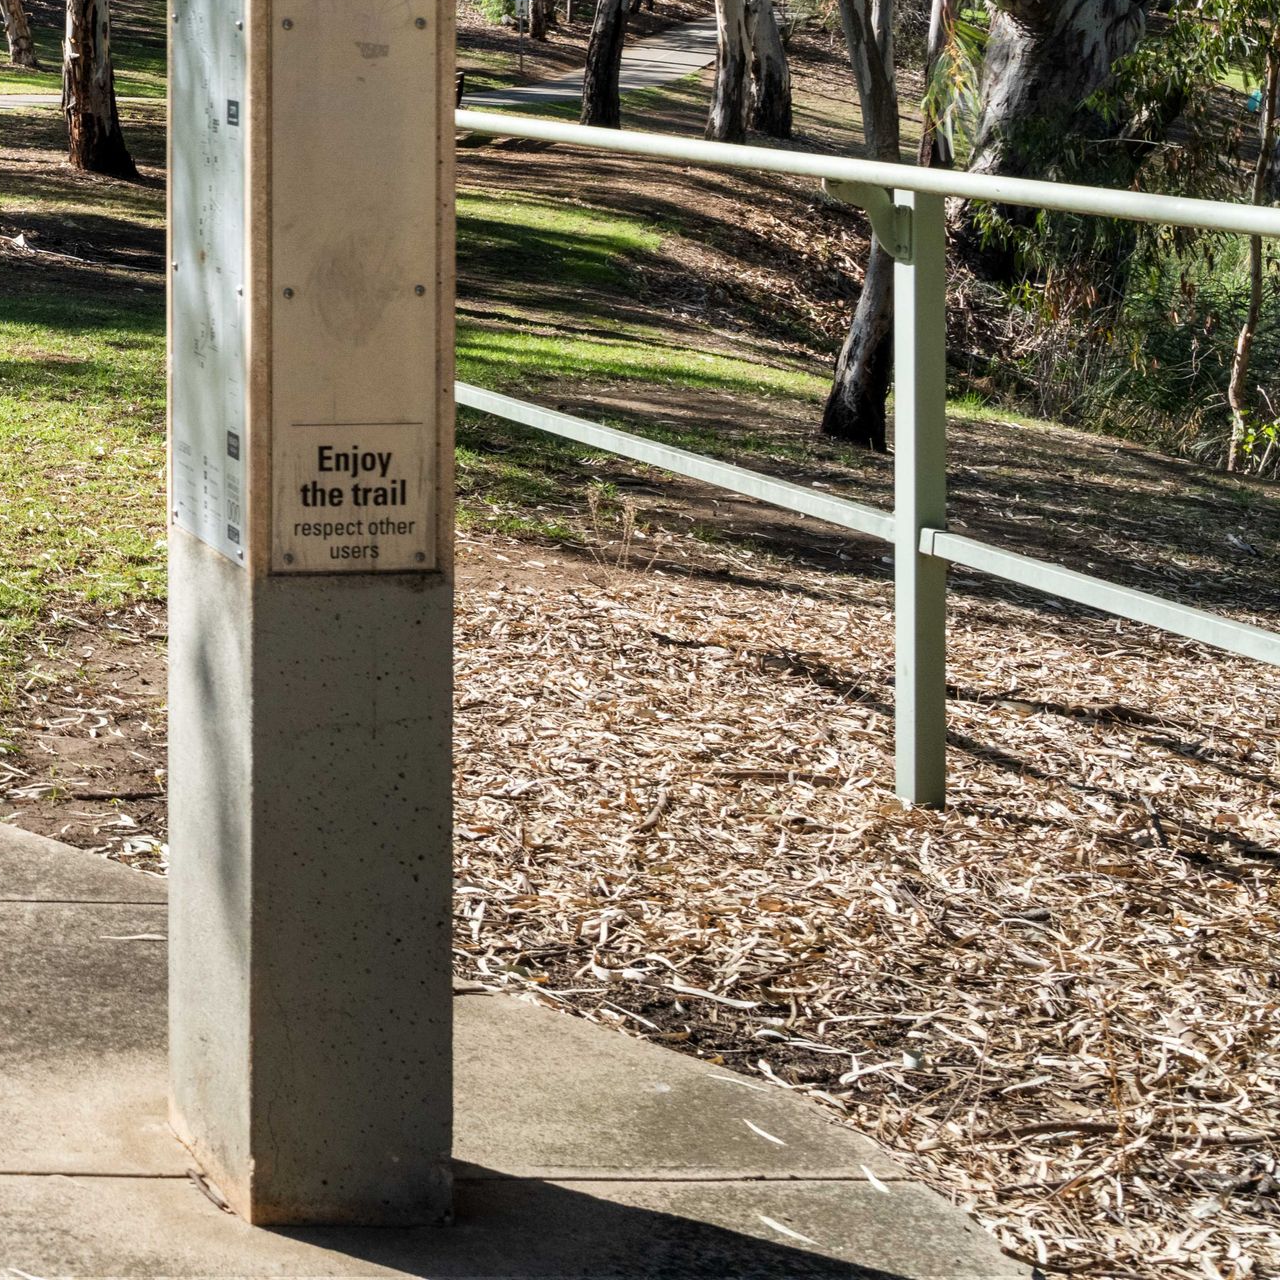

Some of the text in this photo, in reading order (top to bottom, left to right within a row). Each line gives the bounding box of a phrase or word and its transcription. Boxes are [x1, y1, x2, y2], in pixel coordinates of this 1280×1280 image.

[317, 445, 393, 479] Enjoy
[300, 479, 407, 508] the trail
[294, 517, 416, 540] respect other
[330, 545, 380, 560] users
